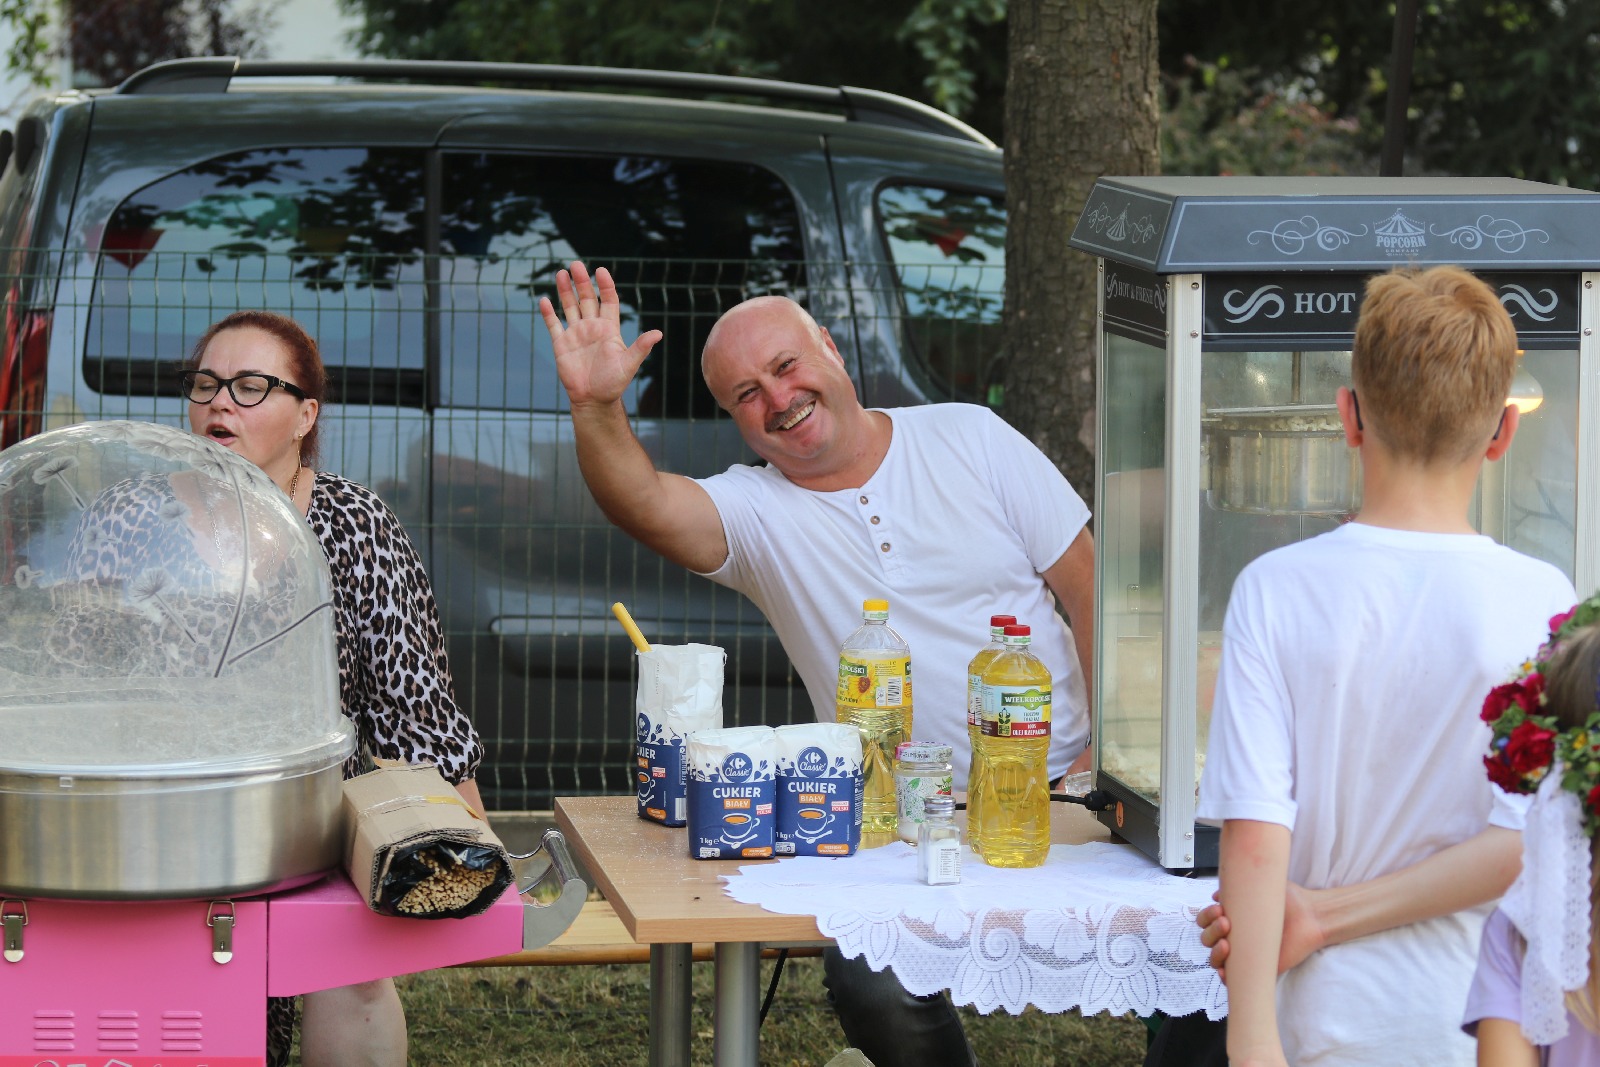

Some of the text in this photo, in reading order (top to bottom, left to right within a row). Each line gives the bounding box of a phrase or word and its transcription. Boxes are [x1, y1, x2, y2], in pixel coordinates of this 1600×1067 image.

[1376, 235, 1426, 248] POPCORN
[1118, 281, 1130, 298] HOT
[1294, 292, 1356, 314] HOT
[713, 787, 761, 798] CUKIER
[788, 781, 836, 794] CUKIER
[725, 800, 749, 808] BIAŁY
[800, 795, 824, 803] BIAŁY
[780, 831, 788, 840] kg
[705, 838, 713, 846] kg
